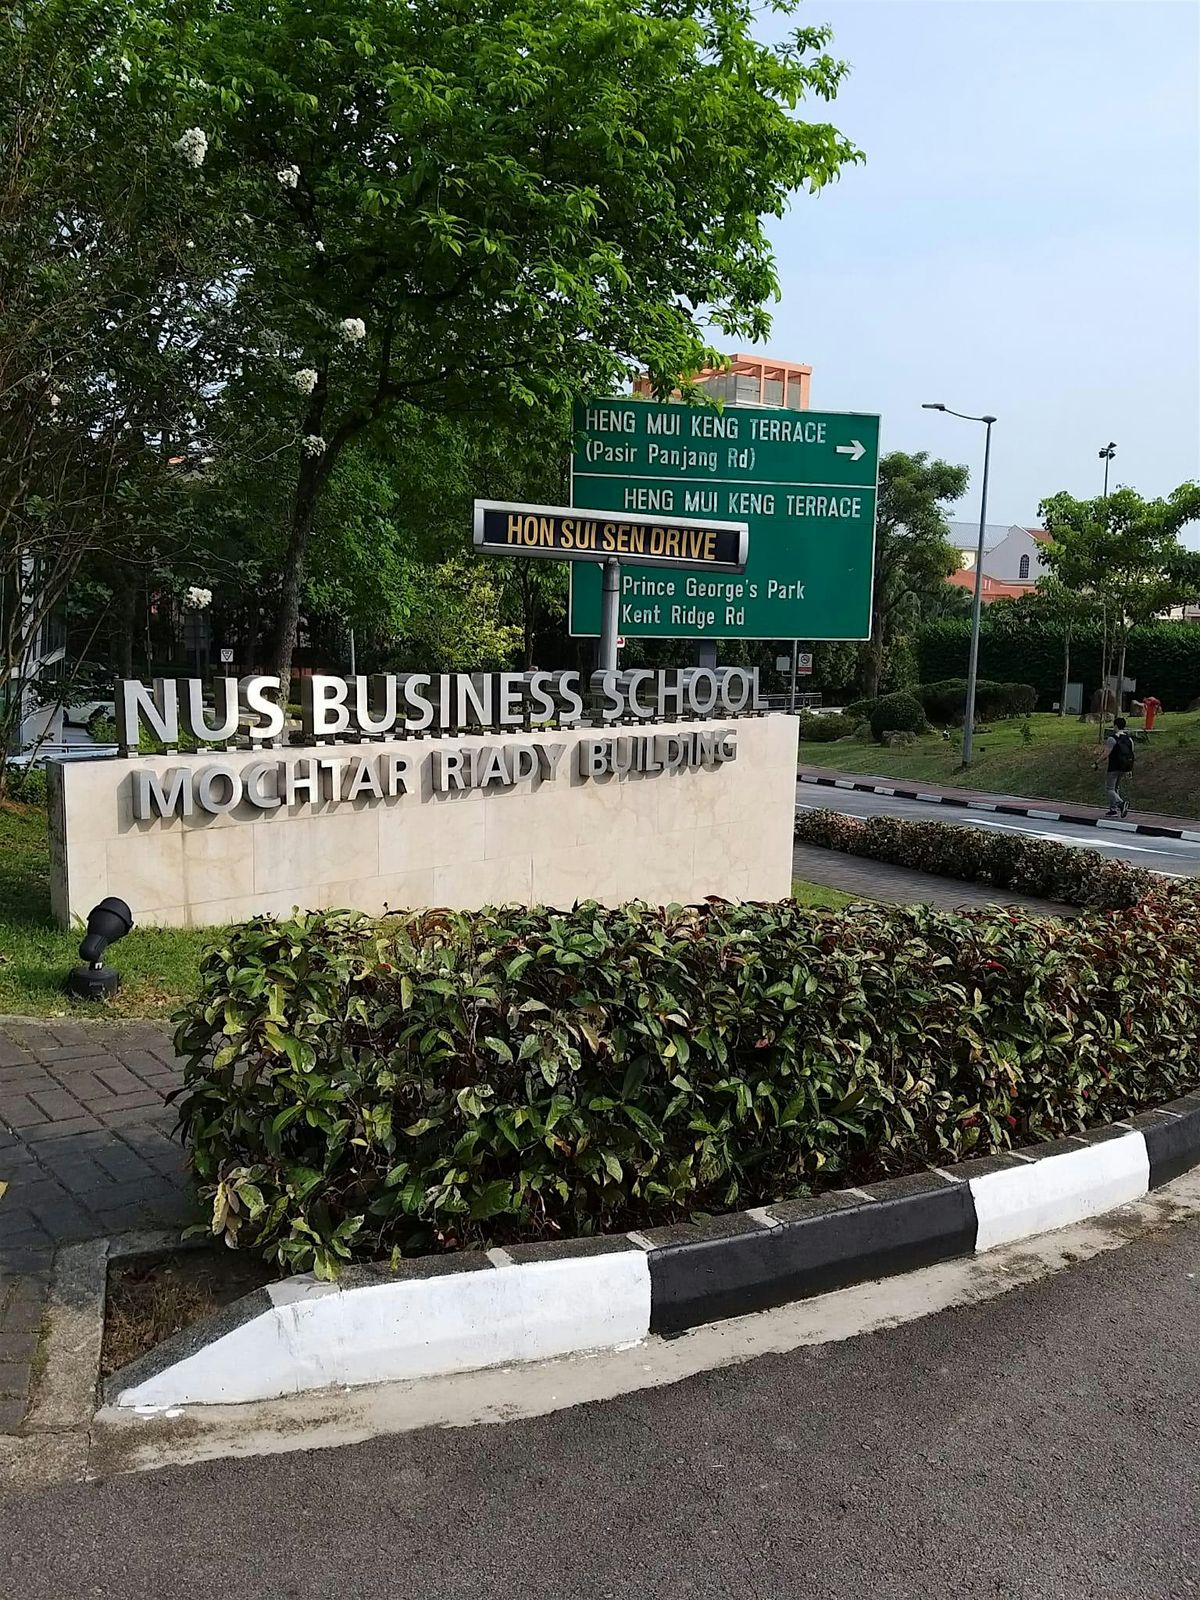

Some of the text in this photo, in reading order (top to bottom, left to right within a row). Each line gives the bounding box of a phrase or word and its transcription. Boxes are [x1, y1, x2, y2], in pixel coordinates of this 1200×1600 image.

[585, 409, 827, 444] HENG MUI KENG TERRACE
[585, 440, 757, 472] (Pasir Panjang Rd)
[624, 488, 862, 518] HENG MUI KENG TERRACE
[507, 514, 717, 560] HON SUI SEN DRIVE
[622, 576, 805, 602] Prince George's Park
[622, 604, 745, 629] Kent Ridge Rd
[123, 666, 769, 746] NUS BUSINESS SCHOOL
[140, 729, 738, 820] MOCHTAR RIADY BUILDING
